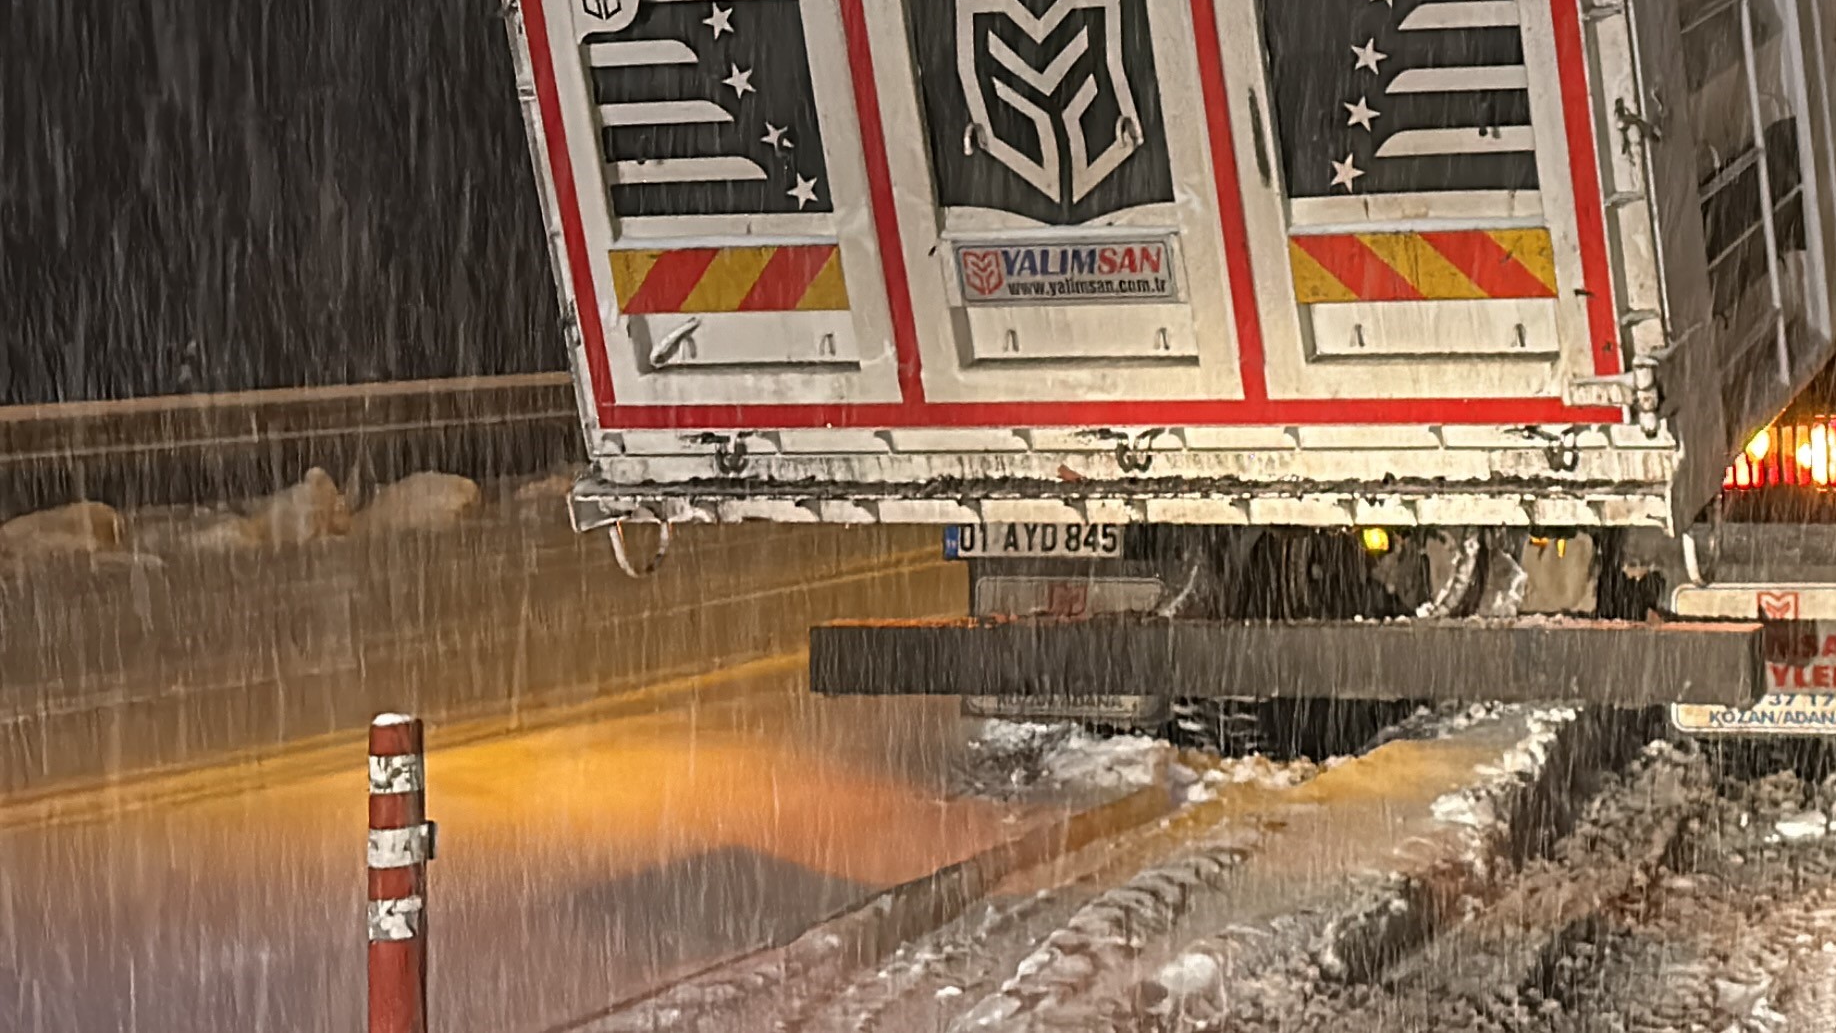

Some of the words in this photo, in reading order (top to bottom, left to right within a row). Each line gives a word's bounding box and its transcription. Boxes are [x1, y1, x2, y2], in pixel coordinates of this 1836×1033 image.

[1001, 246, 1162, 276] YALIMSAN
[1008, 276, 1167, 297] www.yalimsan.com.tr
[960, 523, 988, 552] 01
[1004, 523, 1058, 552] AYD
[1065, 523, 1118, 552] 845
